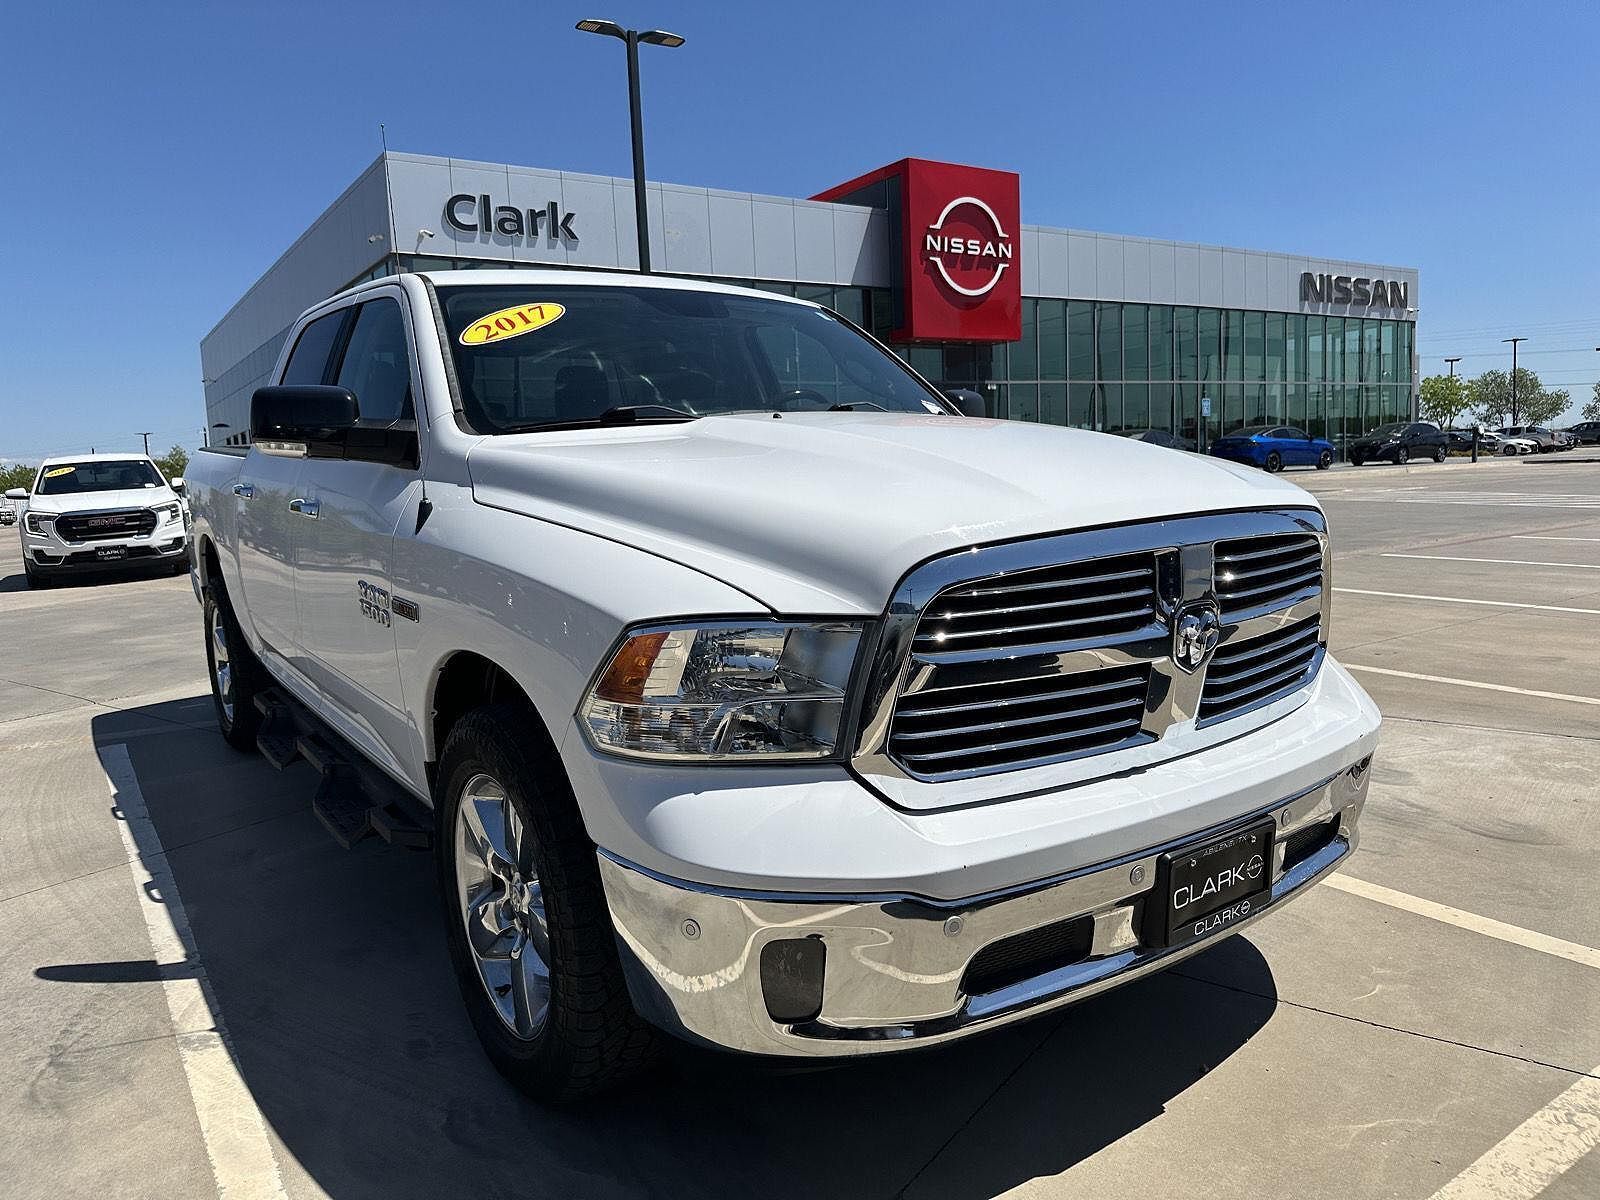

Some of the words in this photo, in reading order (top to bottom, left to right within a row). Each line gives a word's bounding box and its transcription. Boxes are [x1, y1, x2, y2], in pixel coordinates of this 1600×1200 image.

[446, 194, 579, 242] Clark
[926, 234, 1012, 259] NISSAN
[1299, 272, 1408, 309] NISSAN
[475, 305, 545, 341] 2017
[88, 516, 126, 527] GMC
[1173, 862, 1245, 910] CLARK
[1194, 904, 1241, 936] CLARK
